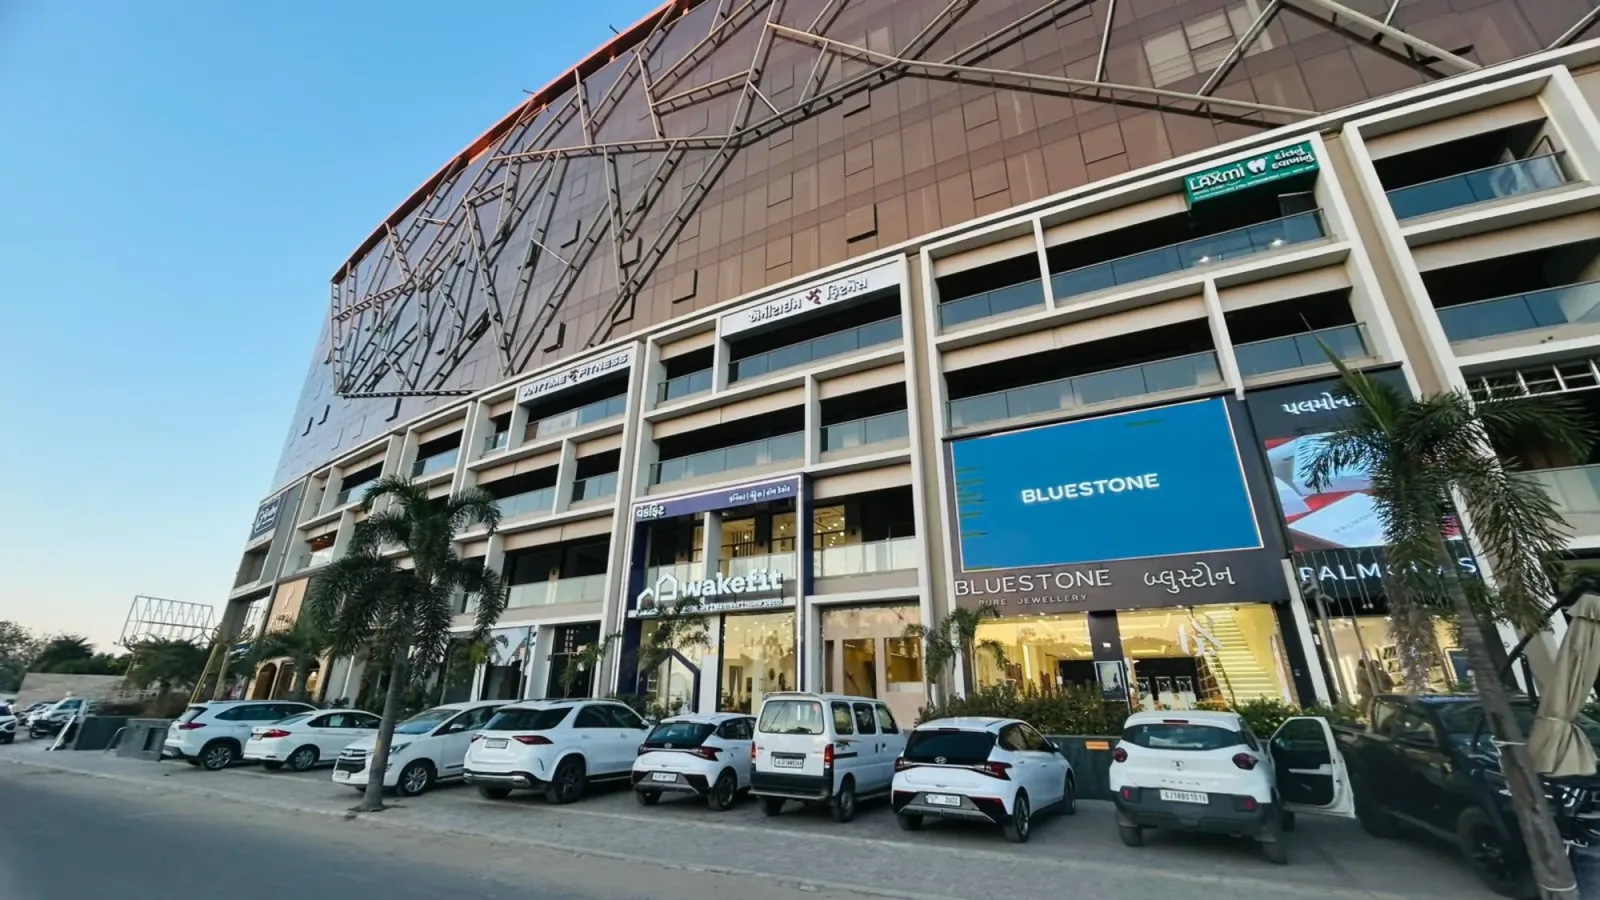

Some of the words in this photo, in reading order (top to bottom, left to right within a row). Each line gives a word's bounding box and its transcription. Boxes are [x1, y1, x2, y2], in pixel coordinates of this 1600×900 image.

[523, 374, 568, 398] ANYTIME
[579, 354, 629, 379] FITNESS
[1021, 473, 1160, 504] BLUESTONE
[681, 568, 783, 598] wakefit
[954, 569, 1113, 596] BLUESTONE
[978, 597, 1008, 607] PURE
[1017, 593, 1088, 606] JEWELLERY
